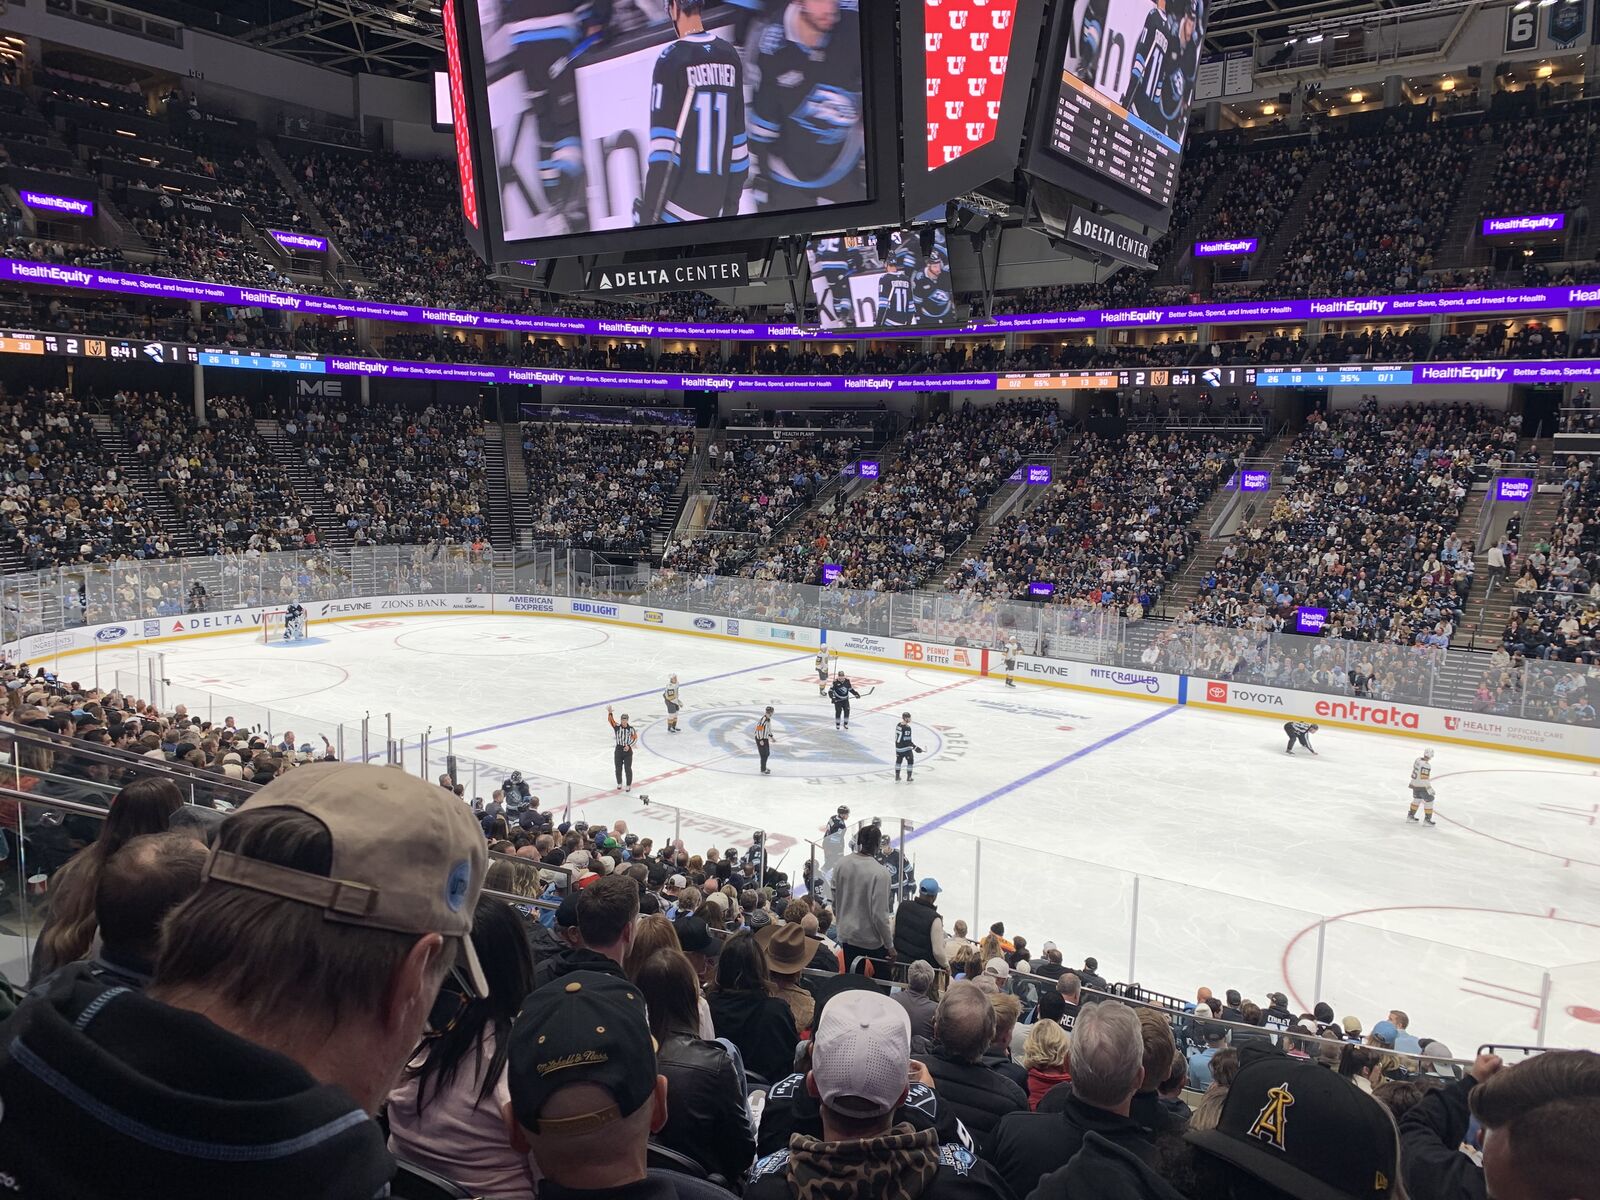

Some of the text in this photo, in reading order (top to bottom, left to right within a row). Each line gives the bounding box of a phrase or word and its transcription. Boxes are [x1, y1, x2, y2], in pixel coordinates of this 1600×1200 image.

[1511, 12, 1534, 43] 6
[686, 63, 736, 88] GUENTHER
[694, 92, 728, 176] 11
[28, 194, 87, 212] HealthEquity
[1491, 217, 1557, 230] HealthEquity
[277, 234, 322, 248] HealthEquity
[1083, 220, 1149, 259] DELTA CENTER
[1201, 242, 1252, 252] HealthEquity
[12, 263, 93, 285] HealthEquity
[98, 276, 119, 284] Better
[121, 279, 138, 287] Save,
[140, 281, 162, 290] Spend,
[615, 263, 740, 287] DELTA CENTER
[241, 291, 301, 308] HealthEquity
[1311, 300, 1388, 313] HealthEquity
[423, 311, 479, 324] HealthEquity
[1101, 311, 1164, 322] HealthEquity
[599, 323, 654, 334] HealthEquity
[18, 342, 31, 351] 30
[46, 342, 58, 352] 16
[66, 339, 78, 353] 2
[110, 346, 137, 358] 8:41
[171, 347, 178, 360] 1
[187, 353, 198, 361] 15
[209, 355, 220, 363] 26
[271, 360, 287, 368] 35%
[333, 360, 389, 374] HealthEquity
[1423, 365, 1507, 379] HealthEquity
[1563, 368, 1592, 376] Spend,
[509, 371, 565, 383] HealthEquity
[682, 378, 735, 388] HealthEquity
[1135, 372, 1145, 384] 2
[1172, 375, 1196, 384] 8:41
[1229, 370, 1235, 383] 1
[1245, 375, 1255, 383] 15
[1267, 375, 1279, 383] 26
[1291, 375, 1302, 383] 18
[1339, 374, 1360, 382] 35%
[1378, 374, 1394, 382] 0/1
[845, 379, 894, 389] HealthEquity
[1502, 482, 1528, 490] Health
[1501, 489, 1529, 498] Equity
[381, 600, 414, 608] ZIONS
[417, 598, 447, 608] BANK
[508, 596, 553, 604] AMERICAN
[330, 602, 371, 613] FILEVINE
[514, 603, 553, 612] EXPRESS
[573, 602, 617, 616] BUD LIGHT
[190, 614, 243, 629] DELTA
[1301, 612, 1324, 620] Health
[696, 619, 713, 628] Ford
[1301, 619, 1325, 628] Equity
[99, 627, 124, 639] Ford
[844, 643, 868, 651] AMERICA
[869, 645, 885, 653] FIRST
[904, 642, 923, 661] PB
[927, 646, 950, 656] PEANUT
[927, 654, 950, 664] BETTER
[1016, 661, 1068, 676] FILEVINE
[1232, 690, 1283, 706] TOYOTA
[1315, 701, 1419, 729] entrata
[1463, 720, 1502, 733] HEALTH
[1507, 726, 1542, 737] OFFICIAL
[1543, 731, 1564, 740] CARE
[1246, 1082, 1295, 1152] A
